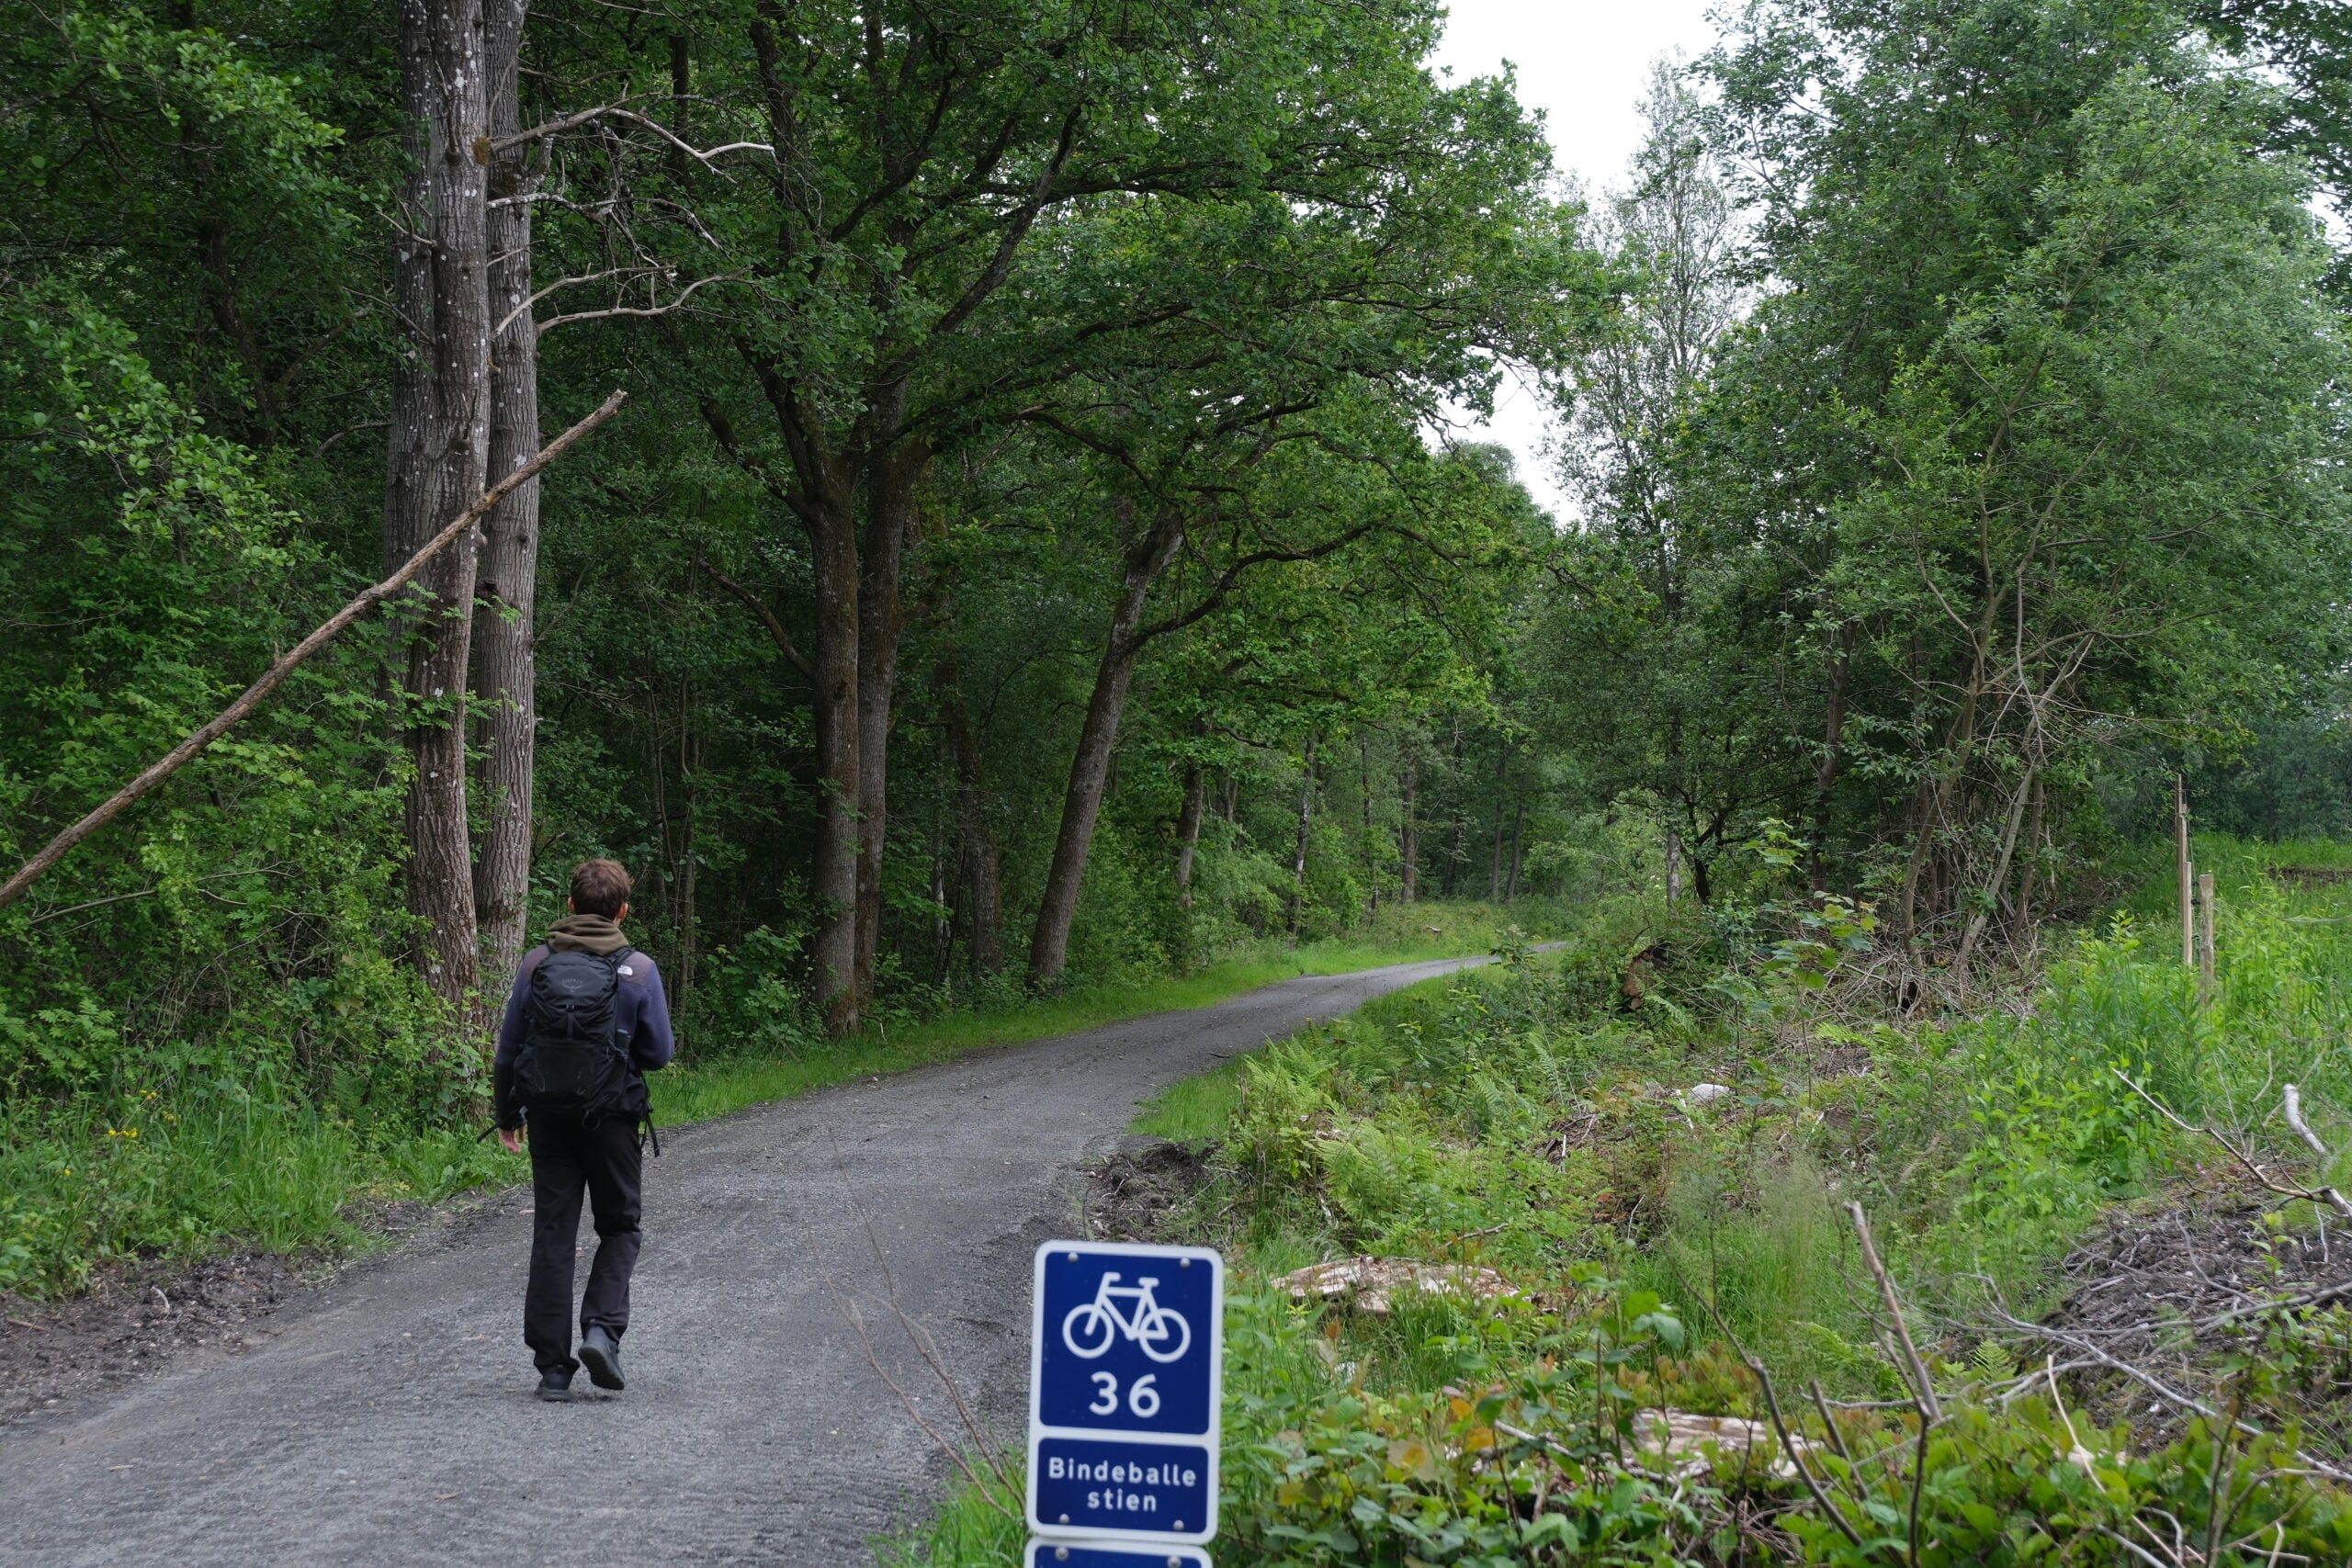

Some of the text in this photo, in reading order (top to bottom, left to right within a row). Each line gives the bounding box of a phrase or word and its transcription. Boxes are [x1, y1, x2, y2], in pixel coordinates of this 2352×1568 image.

[1089, 1371, 1160, 1418] 36
[1048, 1457, 1196, 1487] Bindeballe
[1087, 1488, 1157, 1512] stien
